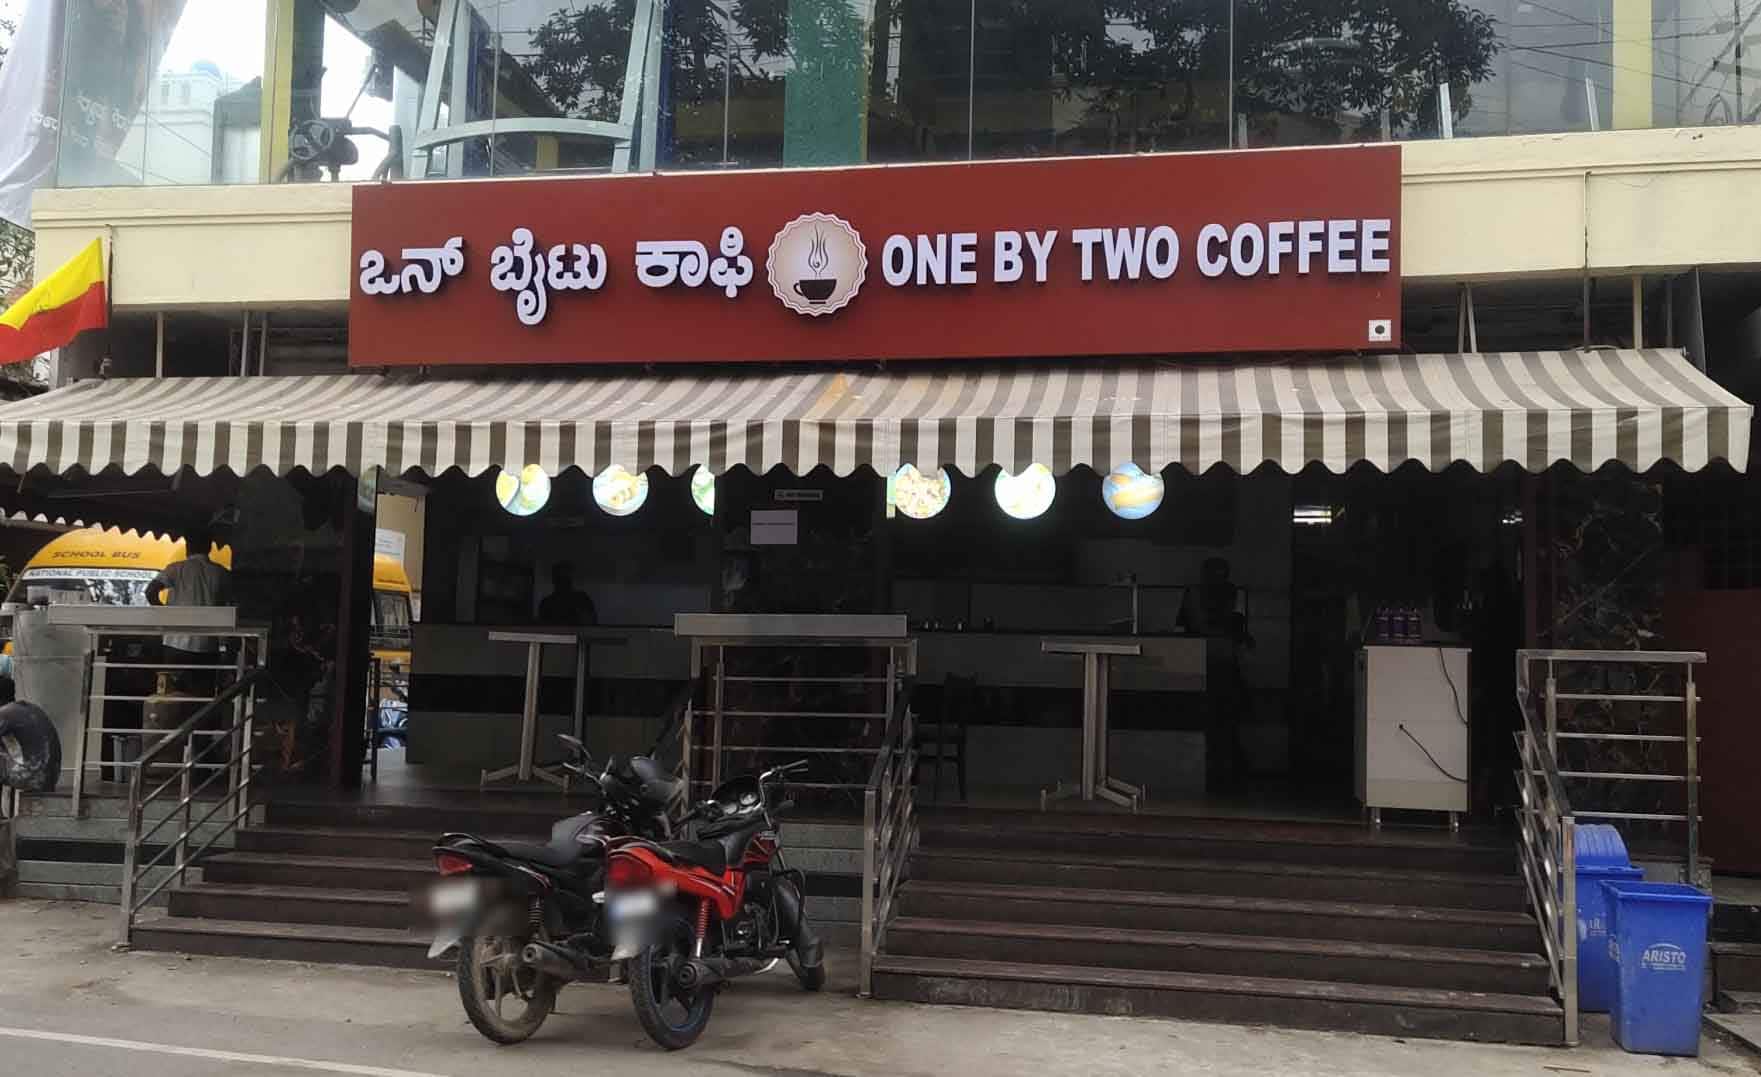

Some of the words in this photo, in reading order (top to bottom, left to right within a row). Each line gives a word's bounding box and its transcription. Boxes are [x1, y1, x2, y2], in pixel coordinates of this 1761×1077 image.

[883, 233, 977, 285] ONE
[995, 231, 1057, 281] BY
[1073, 226, 1179, 280] TWO
[1197, 219, 1390, 276] COFFEE
[360, 237, 463, 294] ಒನ್
[491, 228, 606, 324] ಬೈಟು
[636, 227, 753, 297] ಕಾಫಿ
[52, 551, 106, 559] SCHOOL
[111, 551, 142, 559] BUS
[76, 569, 112, 578] PUBLIC
[1642, 950, 1687, 963] ARISTO
